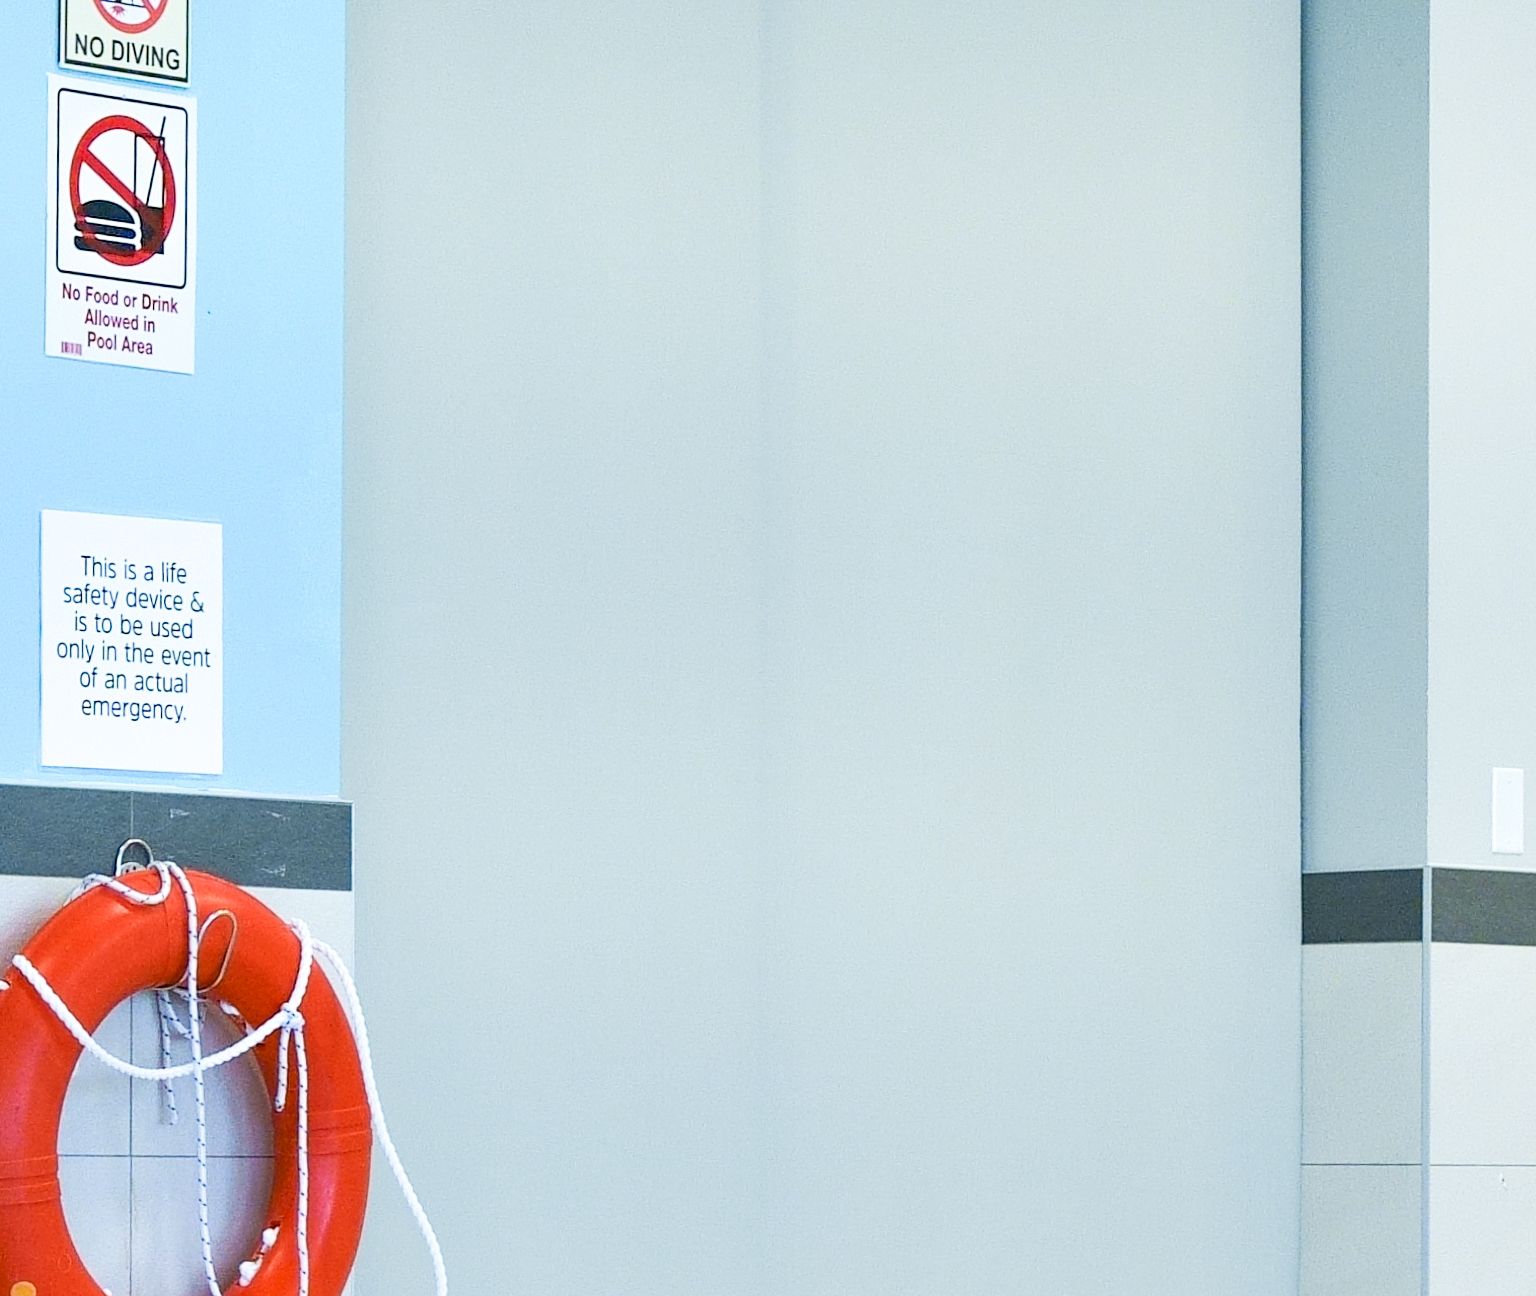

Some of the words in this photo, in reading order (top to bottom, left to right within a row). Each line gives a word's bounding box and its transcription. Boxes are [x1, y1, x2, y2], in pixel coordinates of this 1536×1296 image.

[74, 33, 104, 58] NO
[112, 39, 180, 70] DIVING
[62, 282, 81, 301] No
[85, 285, 119, 308] Food
[123, 292, 138, 308] or
[142, 292, 179, 314] Drink
[84, 308, 139, 332] Allowed
[142, 315, 156, 333] in
[87, 331, 117, 351] Pool
[121, 335, 153, 355] Area
[81, 555, 117, 580] This
[124, 559, 137, 581] is
[144, 565, 155, 582] a
[161, 561, 188, 584] life
[63, 583, 119, 609] safety
[126, 587, 183, 611] device
[190, 591, 205, 613] &
[74, 610, 87, 632] is
[95, 613, 113, 634] to
[120, 615, 143, 636] be
[151, 618, 194, 639] used
[56, 640, 95, 663] only
[102, 641, 117, 661] in
[125, 642, 154, 664] the
[161, 647, 211, 668] event
[80, 667, 97, 688] of
[105, 673, 127, 690] an
[134, 673, 188, 694] actual
[81, 699, 187, 724] emergency.
